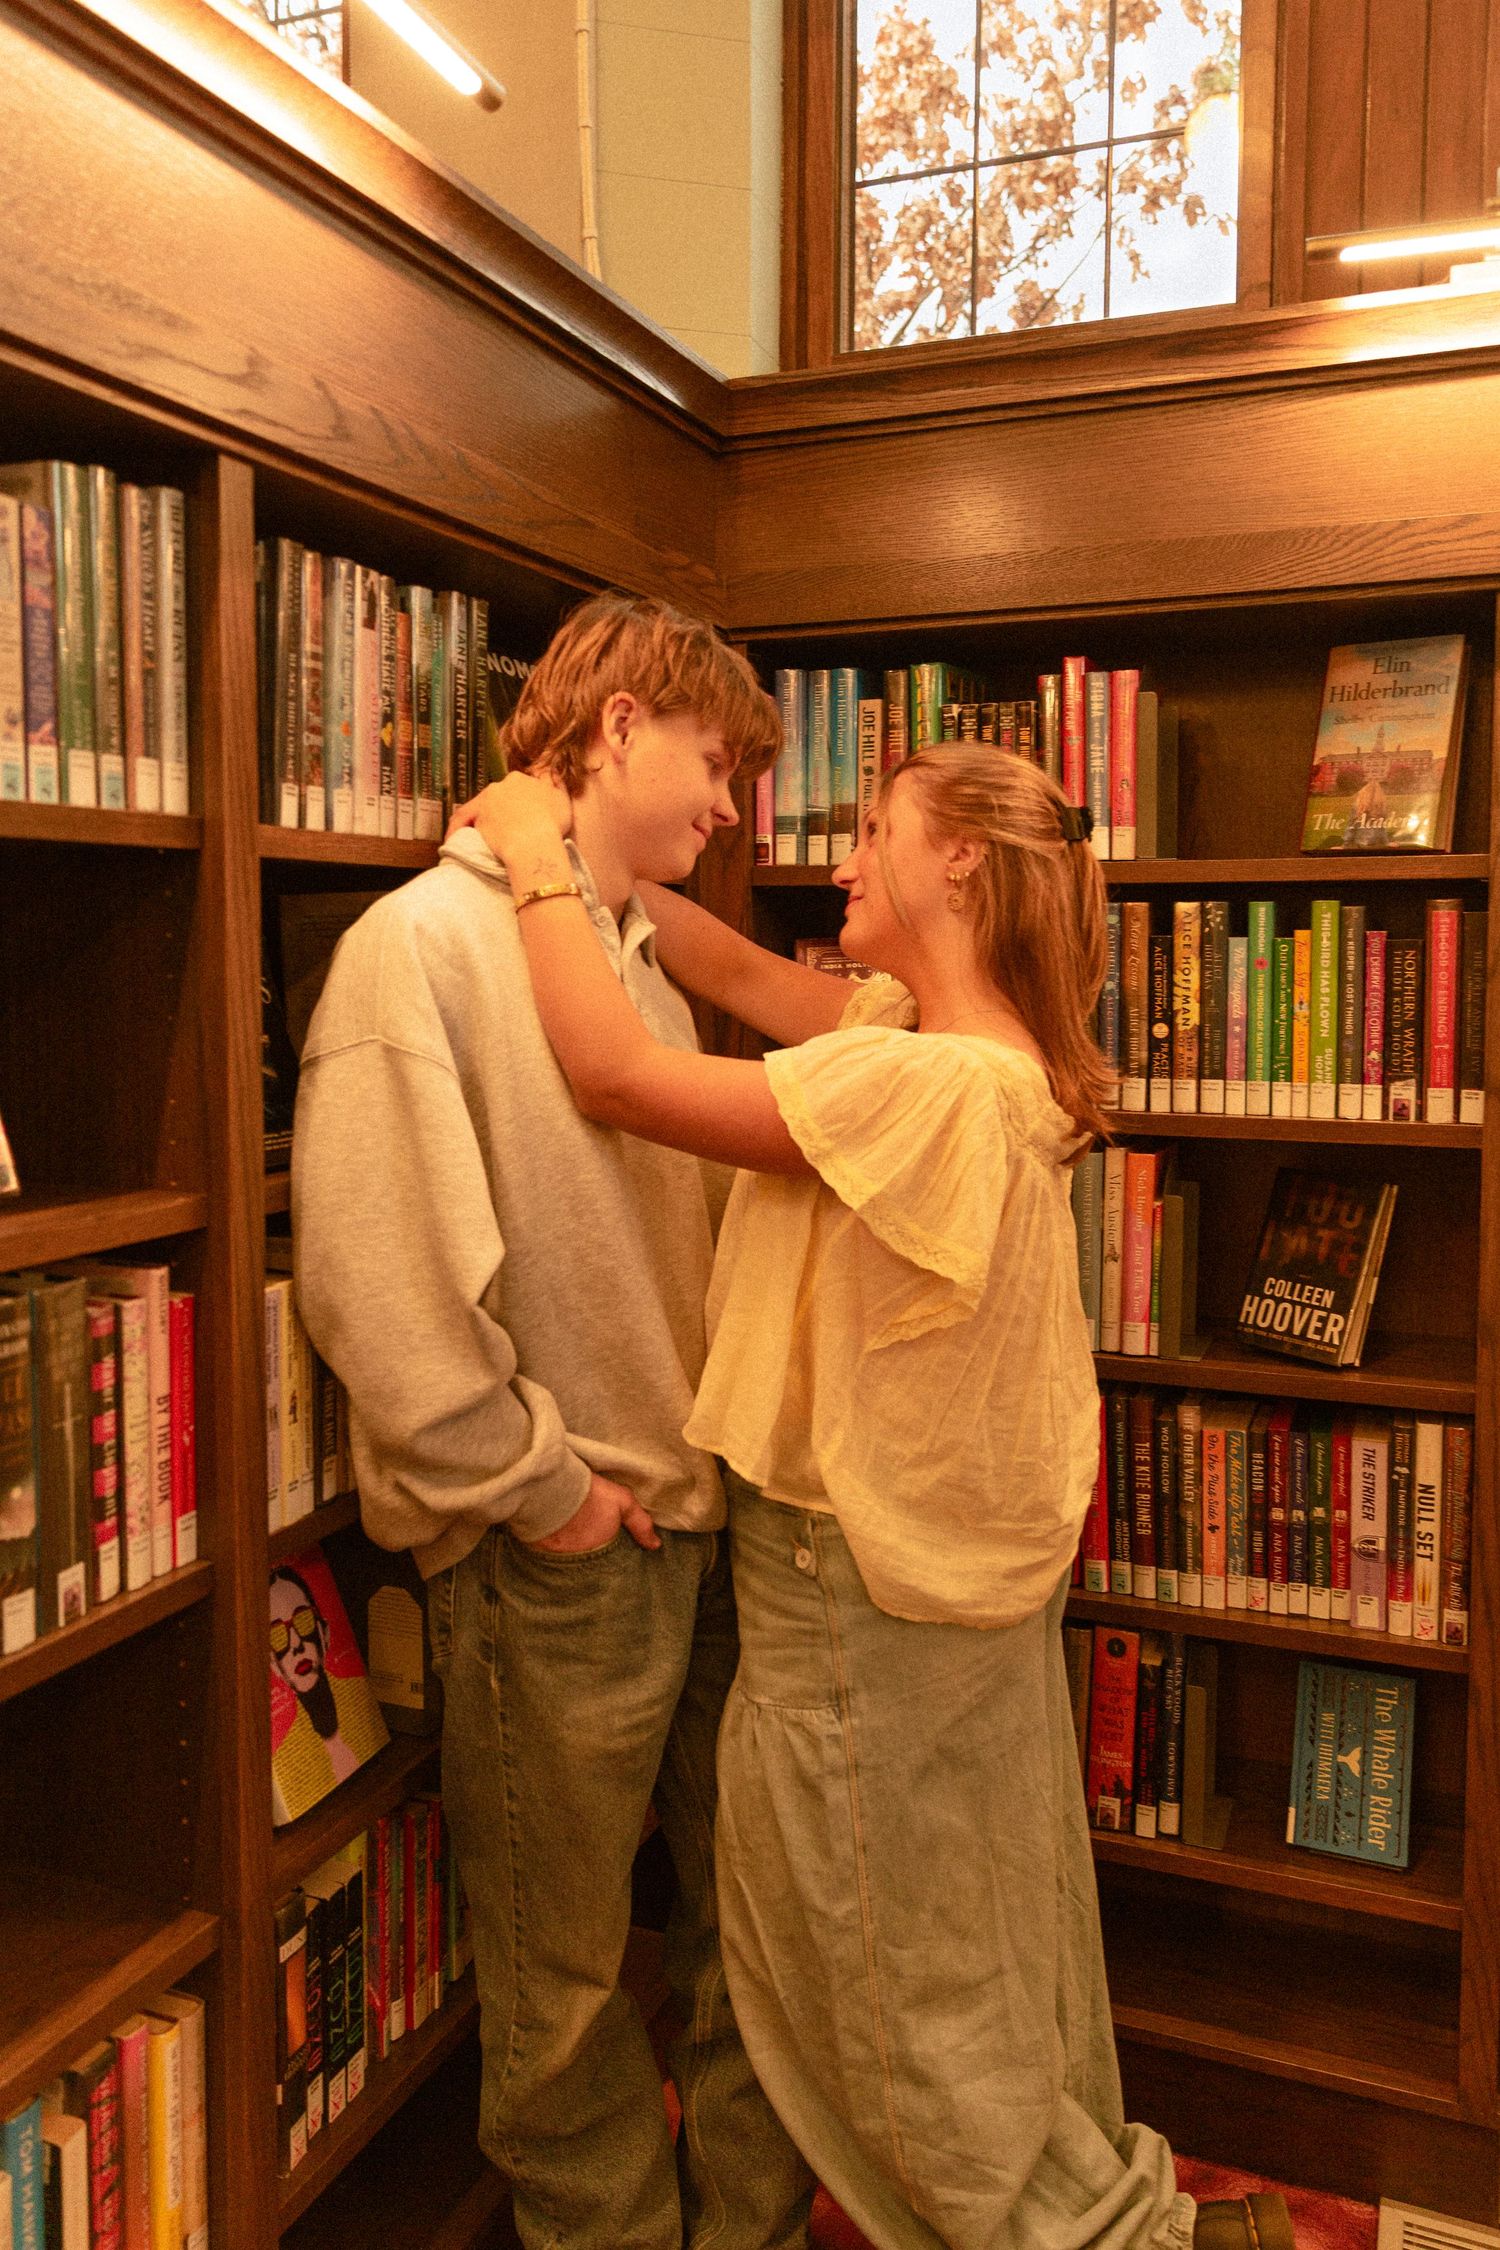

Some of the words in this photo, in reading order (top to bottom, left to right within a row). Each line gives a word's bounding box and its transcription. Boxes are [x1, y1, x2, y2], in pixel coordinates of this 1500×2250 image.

[476, 610, 487, 645] JANE
[456, 628, 468, 665] JANE
[1372, 655, 1411, 675] Elin
[476, 656, 487, 718] HARPER
[838, 678, 846, 696] Elin
[1090, 682, 1104, 718] FIONA
[1328, 675, 1450, 703] Hilderbrand
[456, 673, 468, 739] HARPER
[862, 707, 875, 730] JOE
[889, 703, 903, 725] JOE
[814, 706, 824, 761] Hilderbrand
[837, 700, 847, 756] Hilderbrand
[889, 730, 904, 753] HILL
[1019, 727, 1031, 744] TONY
[862, 735, 876, 762] HILL
[1090, 744, 1104, 774] JANE
[863, 779, 873, 801] FULL
[1313, 814, 1345, 830] The
[1183, 911, 1192, 949] ALICE
[1321, 912, 1332, 939] THIS
[1440, 918, 1450, 940] THE
[1154, 946, 1162, 972] ALICE
[1320, 941, 1330, 968] BIRD
[1346, 941, 1355, 971] KEEPER
[1371, 939, 1381, 955] YOU
[1440, 942, 1449, 966] GOD
[1204, 944, 1213, 990] HOFFMAN
[1371, 956, 1381, 989] DESERVE
[1440, 971, 1448, 984] OF
[1182, 956, 1191, 1027] HOFFMAN
[1230, 967, 1245, 1019] Prospects
[1256, 974, 1264, 988] THE
[1320, 970, 1330, 994] HAS
[1346, 983, 1354, 1004] LOST
[1404, 950, 1416, 1021] NORTHERN
[1154, 974, 1162, 1019] HOFFMAN
[1371, 992, 1380, 1016] EACH
[1129, 1007, 1139, 1034] ALICE
[1279, 1003, 1288, 1020] NEW
[1320, 997, 1329, 1038] FLOWN
[1345, 1006, 1354, 1035] THINGS
[1392, 997, 1401, 1028] KOLD
[1439, 991, 1448, 1038] ENDINGS
[1256, 1032, 1264, 1052] SALLY
[1371, 1018, 1381, 1045] OTHER
[1391, 1035, 1401, 1073] HOLDT
[1403, 1028, 1416, 1073] WRATH
[1108, 1174, 1121, 1200] Miss
[1136, 1169, 1147, 1192] Nick
[1083, 1167, 1092, 1251] GODMERSHAM
[1135, 1196, 1146, 1233] Hornby
[1107, 1209, 1120, 1246] Austen
[1135, 1243, 1145, 1265] Just
[1083, 1258, 1091, 1284] PARK
[1134, 1268, 1144, 1290] Like
[1133, 1294, 1143, 1313] You
[1263, 1277, 1336, 1309] COLLEEN
[1239, 1294, 1345, 1346] HOOVER
[156, 1393, 170, 1415] BY
[1117, 1421, 1125, 1444] WITH
[1185, 1413, 1194, 1430] THE
[156, 1423, 170, 1456] THE
[1134, 1442, 1150, 1460] THE
[1161, 1426, 1169, 1451] WOLF
[1185, 1434, 1194, 1465] OTHER
[1208, 1434, 1220, 1451] On
[1230, 1435, 1242, 1453] The
[1117, 1454, 1125, 1477] MIND
[1208, 1454, 1221, 1471] the
[1362, 1446, 1376, 1470] THE
[156, 1459, 170, 1507] BOOK
[1117, 1479, 1125, 1491] TO
[1135, 1466, 1150, 1489] KITE
[1161, 1455, 1169, 1494] HOLLOW
[1208, 1474, 1220, 1496] Plus
[1251, 1453, 1264, 1491] BEACON
[1185, 1469, 1194, 1503] VALLEY
[1362, 1471, 1376, 1521] STRIKER
[1117, 1492, 1125, 1511] KILL
[1136, 1493, 1151, 1536] RUNNER
[1208, 1499, 1221, 1520] Side
[1398, 1490, 1406, 1526] EMPEROR
[1416, 1482, 1436, 1525] NULL
[1231, 1512, 1243, 1536] Test
[1253, 1531, 1263, 1553] HUGH
[1273, 1533, 1282, 1552] ANA
[1294, 1535, 1303, 1555] ANA
[1314, 1535, 1324, 1556] ANA
[1337, 1538, 1346, 1556] ANA
[1416, 1530, 1434, 1561] SET
[1174, 1657, 1182, 1686] BLACK
[1173, 1689, 1181, 1724] WOODS
[1373, 1686, 1400, 1723] The
[1319, 1712, 1336, 1740] WITI
[1100, 1746, 1125, 1759] JAMES
[1167, 1742, 1176, 1776] EOWYN
[1370, 1728, 1396, 1789] Whale
[1315, 1742, 1333, 1801] IHIMAERA
[1167, 1777, 1175, 1798] IVEY
[1367, 1796, 1393, 1851] Rider
